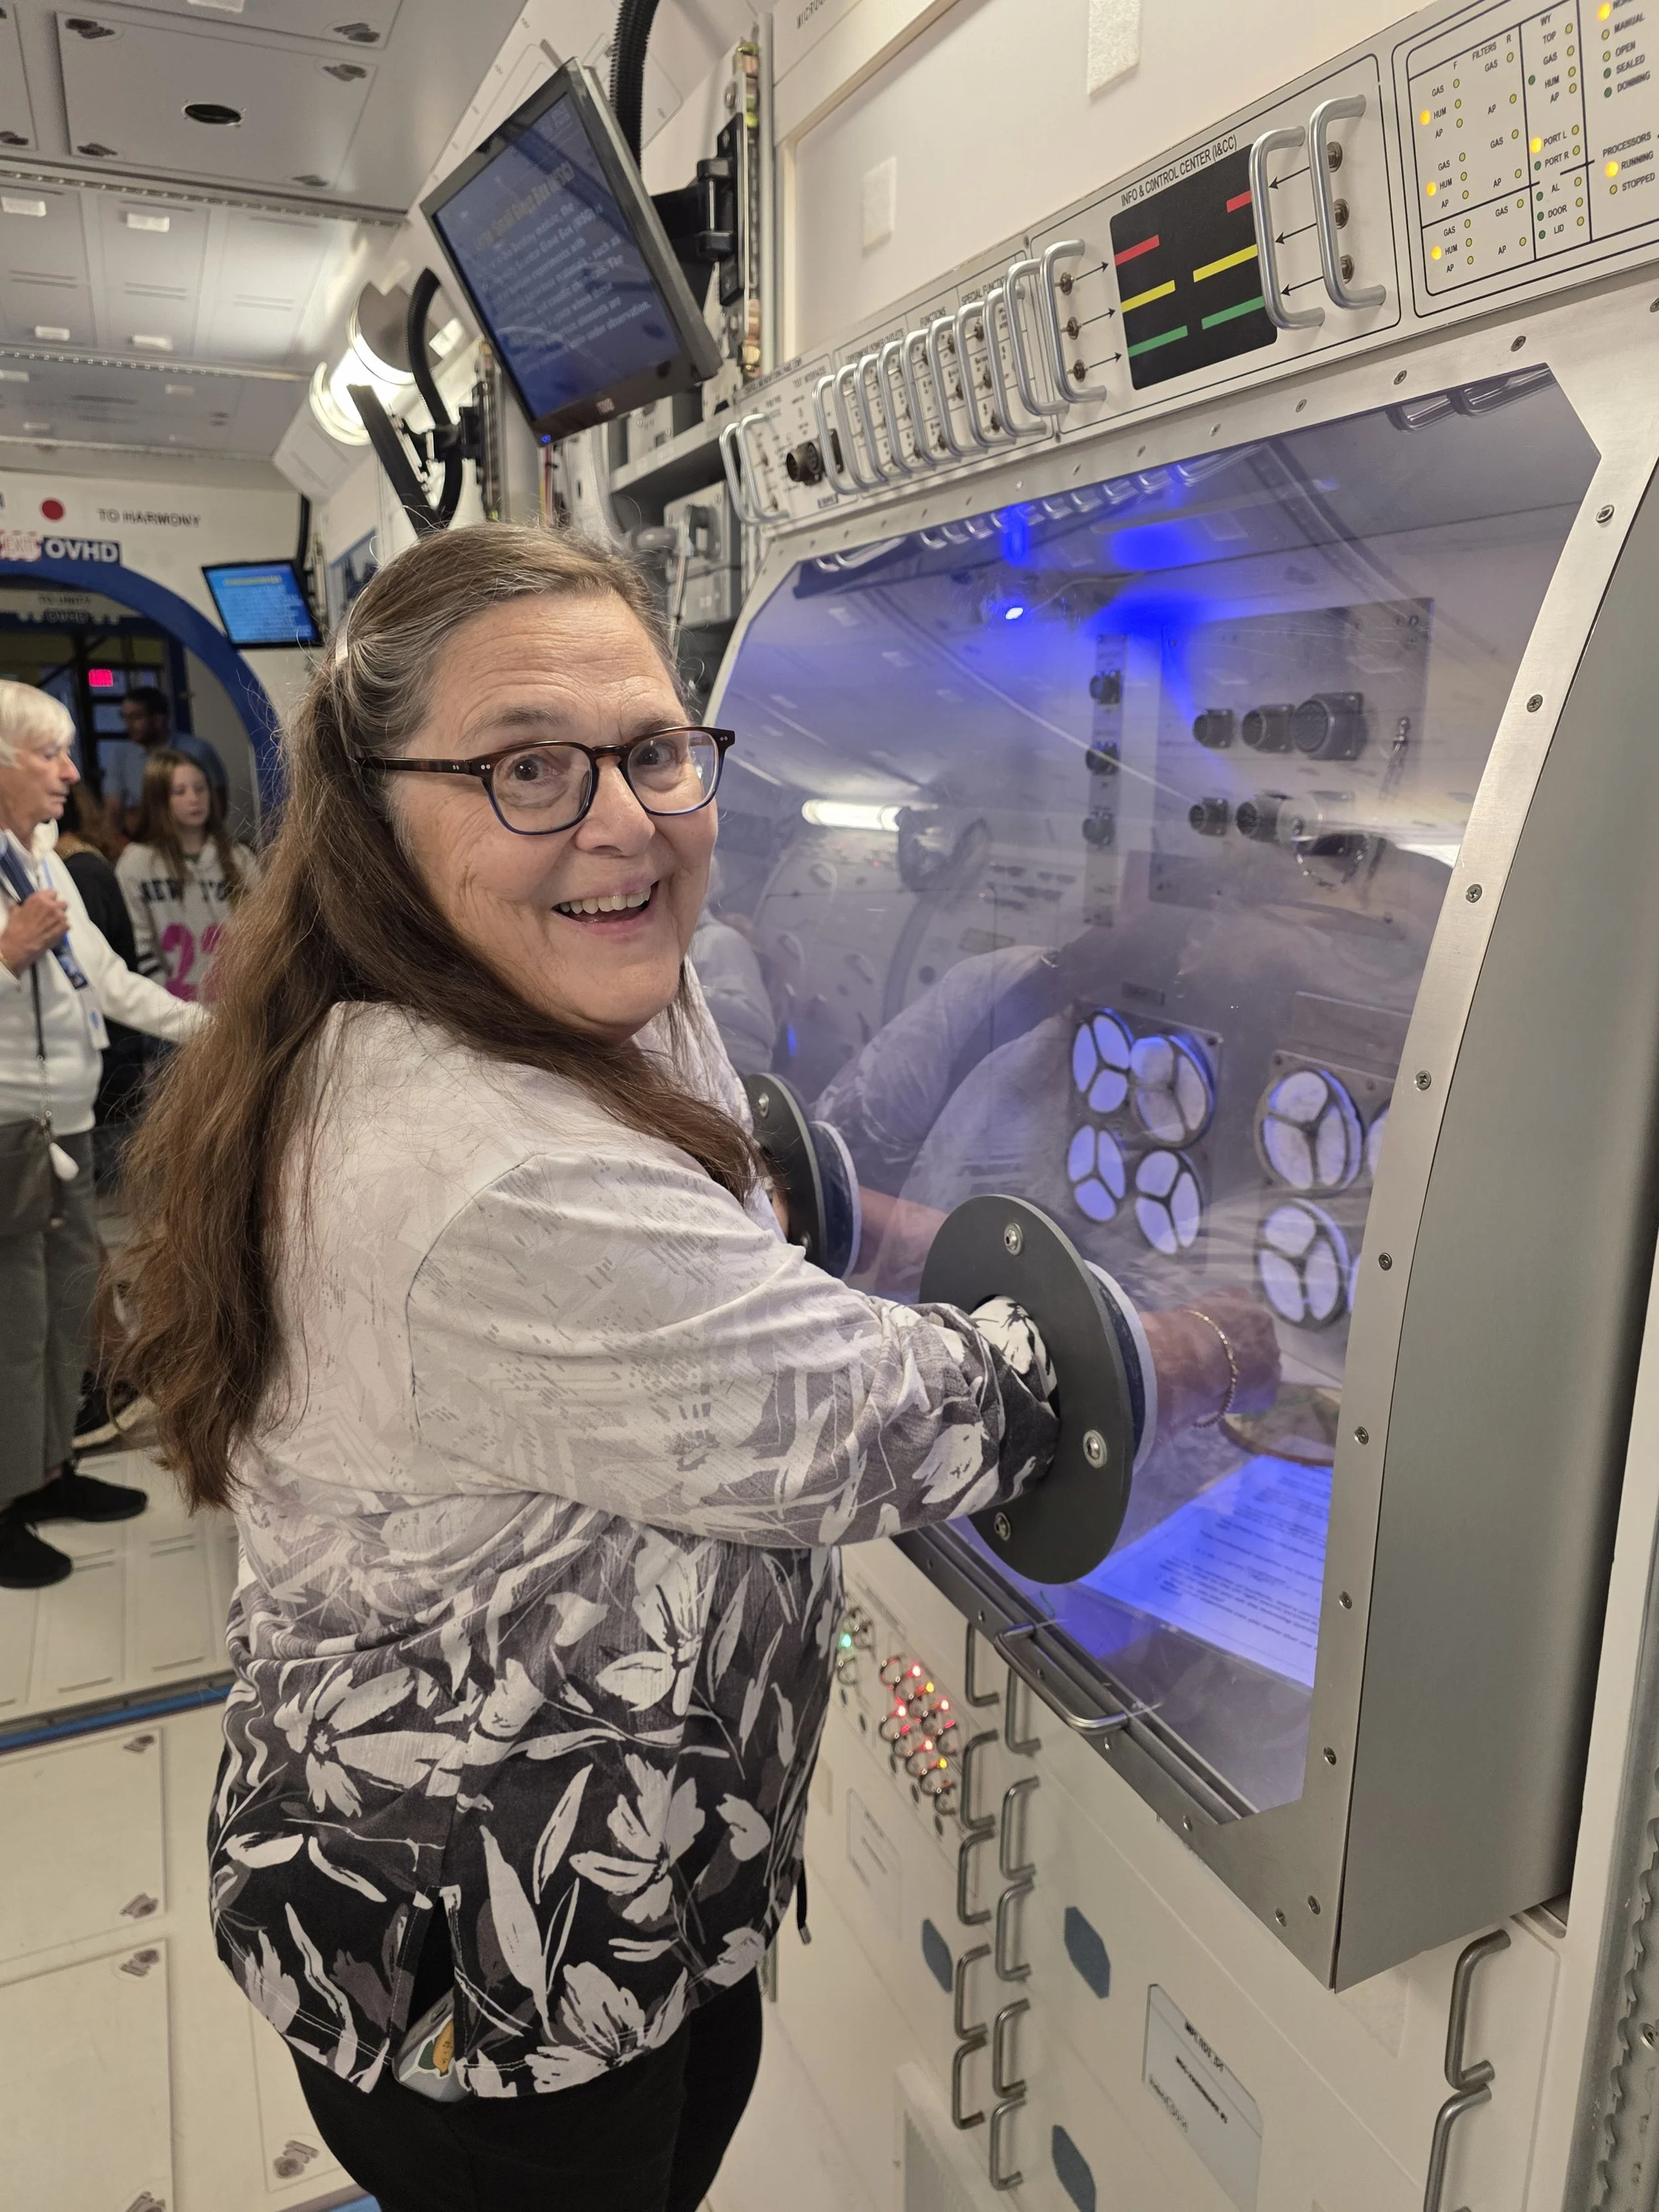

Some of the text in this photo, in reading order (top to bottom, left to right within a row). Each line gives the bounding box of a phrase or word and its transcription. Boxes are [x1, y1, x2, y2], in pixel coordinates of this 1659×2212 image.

[1542, 31, 1556, 44] TOP
[1453, 34, 1512, 70] F FILTERS R
[1615, 40, 1636, 57] OPEN
[1543, 52, 1557, 66] GAS
[1616, 54, 1646, 74] SEALED
[1484, 59, 1498, 72] GAS
[1545, 75, 1559, 89] HUM
[1432, 85, 1444, 97] GAS
[1550, 92, 1559, 104] AP
[1433, 107, 1447, 119] HUM
[1488, 104, 1496, 115] AP
[1435, 128, 1443, 139] AP
[1544, 130, 1567, 147] PORT L
[1490, 137, 1504, 149] GAS
[1603, 131, 1652, 158] PROCESSORS
[1438, 160, 1451, 171] GAS
[1545, 151, 1569, 168] PORT R
[1621, 151, 1654, 170] RUNNING
[1121, 134, 1238, 207] INFO & CONTROL CENTER (I&CC)
[1439, 178, 1453, 190] HUM
[1493, 178, 1502, 188] AP
[1622, 172, 1656, 192] STOPPED
[1551, 183, 1560, 194] AL
[1441, 199, 1449, 209] AP
[1495, 206, 1508, 217] GAS
[1548, 204, 1567, 218] DOOR
[1443, 226, 1456, 236] GAS
[1554, 224, 1565, 234] LID
[1445, 244, 1458, 256] HUM
[1498, 245, 1506, 256] AP
[1447, 263, 1454, 273] AP
[98, 508, 200, 528] TO HARMONY
[44, 538, 119, 563] OVHD
